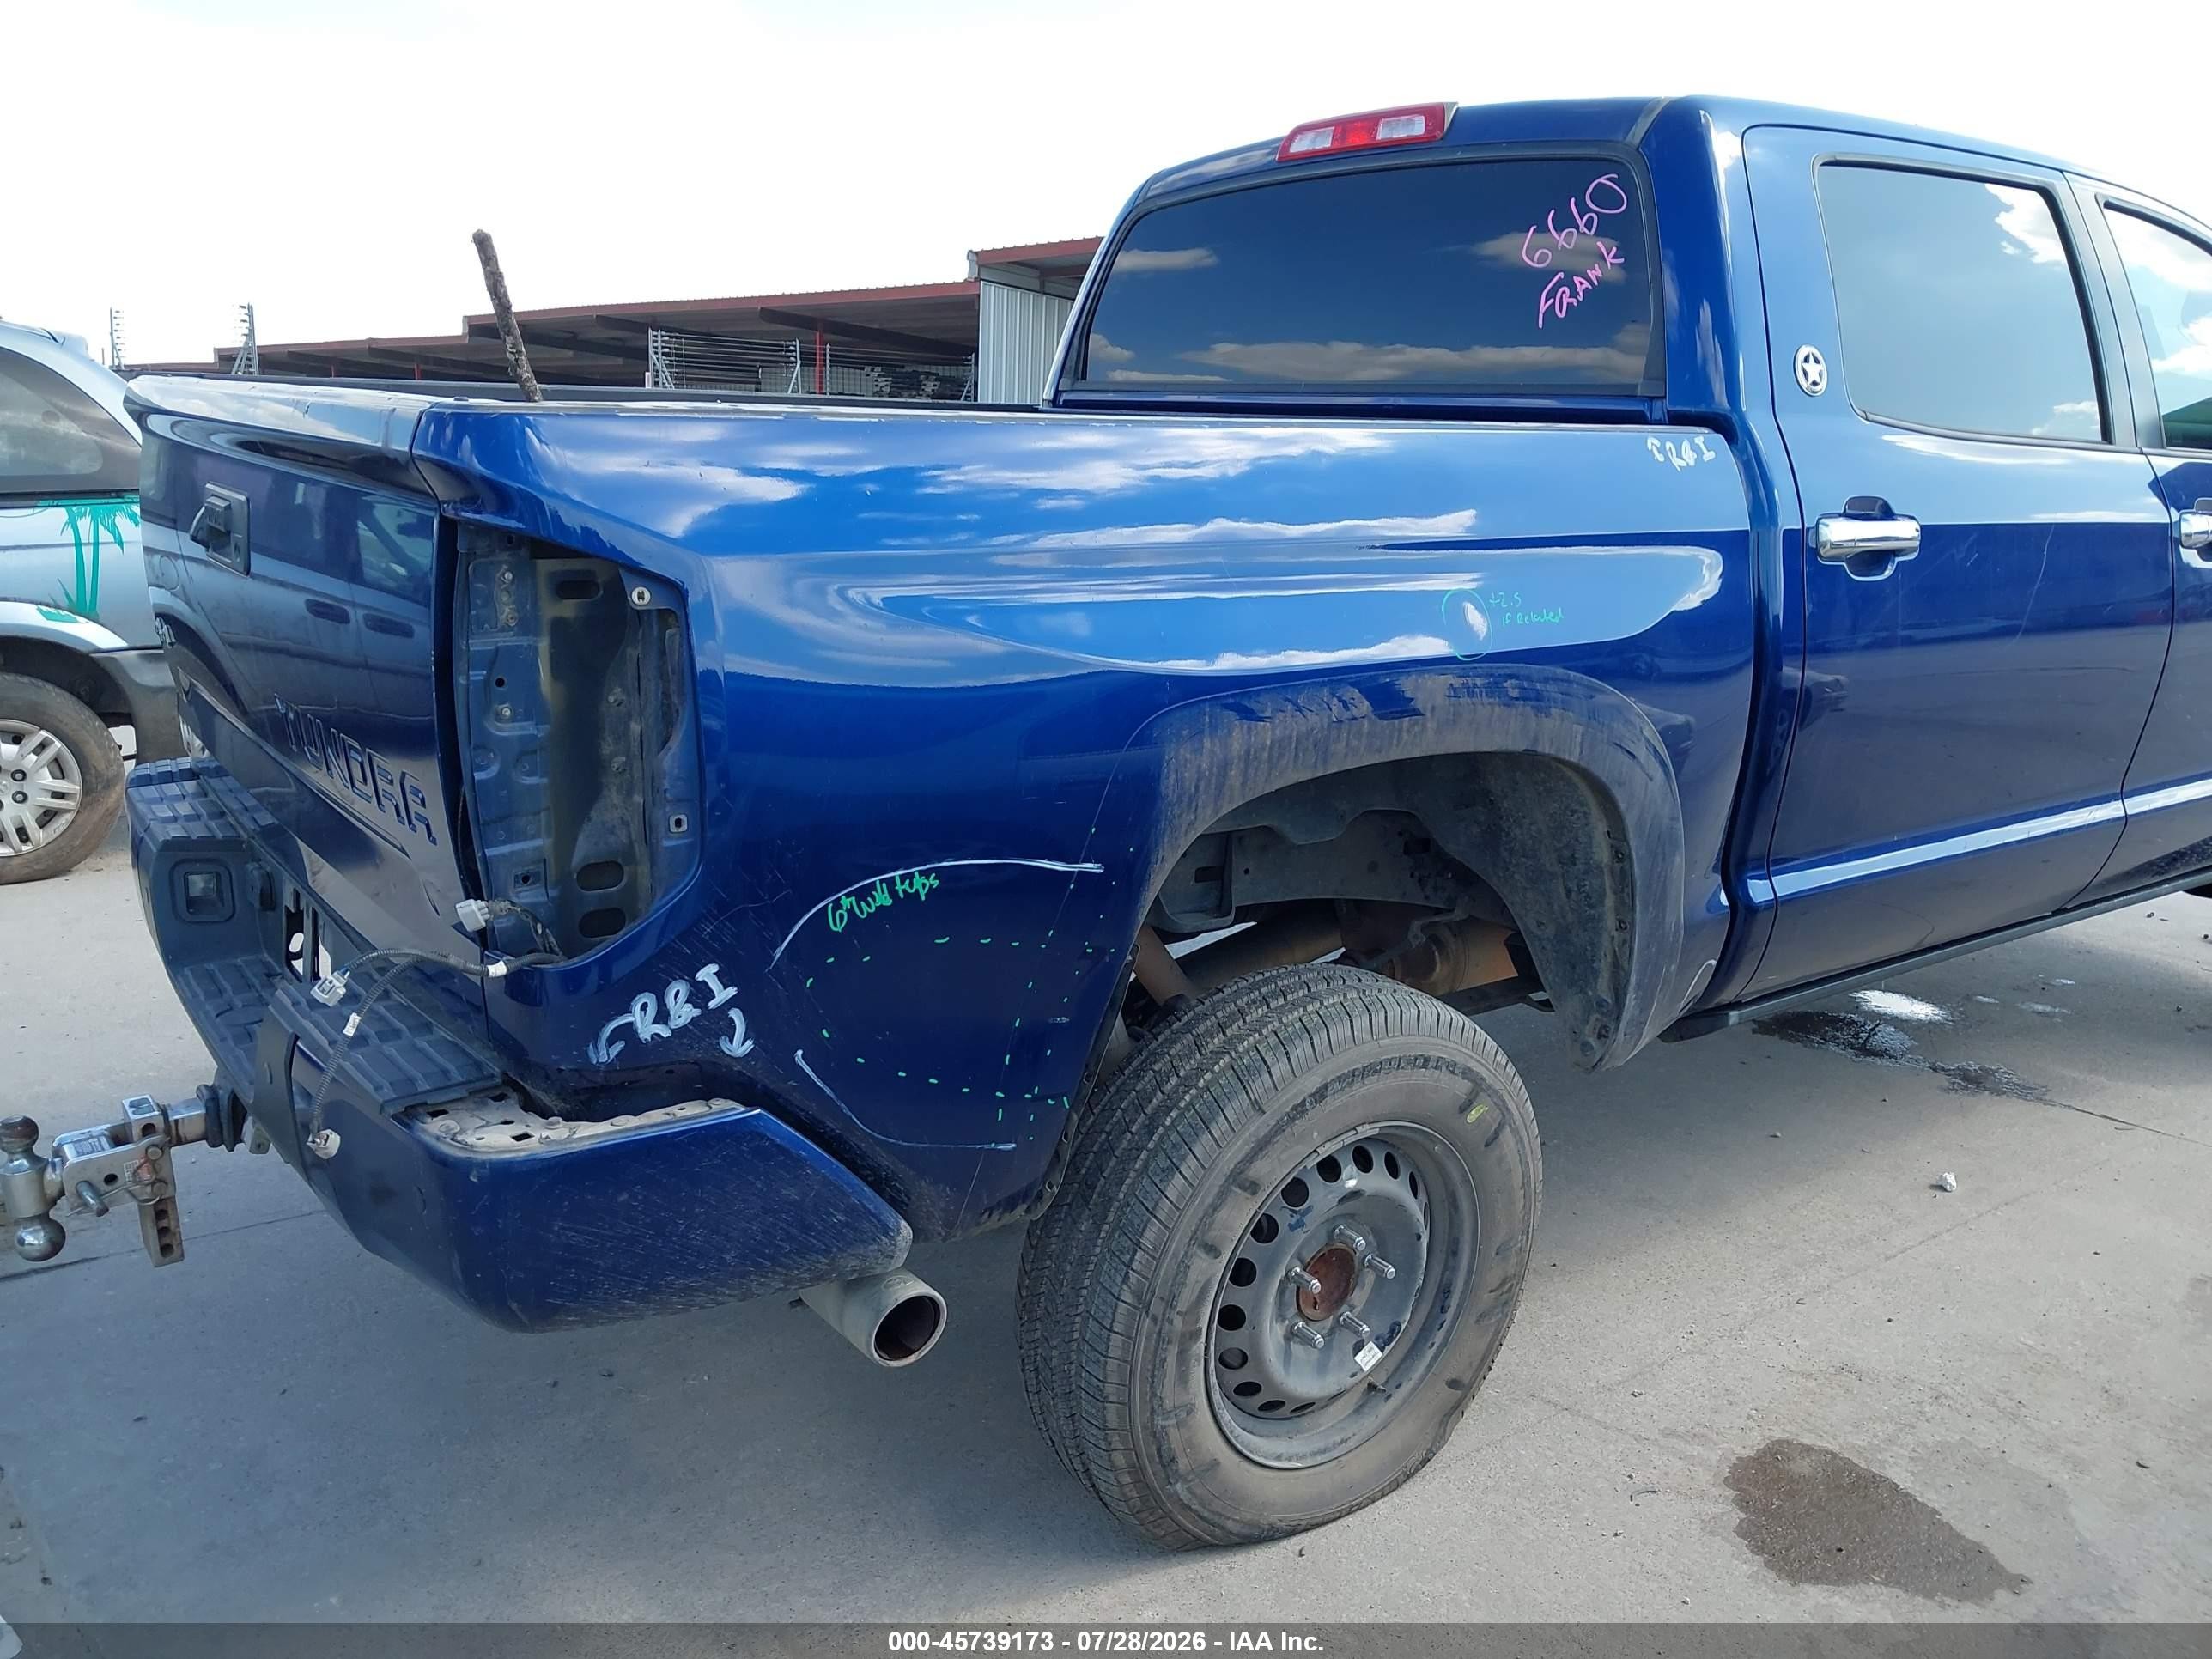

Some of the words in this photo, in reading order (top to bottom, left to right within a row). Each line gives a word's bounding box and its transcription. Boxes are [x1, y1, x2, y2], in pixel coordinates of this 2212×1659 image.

[1521, 173, 1628, 269] 6660
[1537, 240, 1626, 330] FRANK
[273, 692, 438, 847] TUNDRA
[629, 962, 738, 1044] R&I
